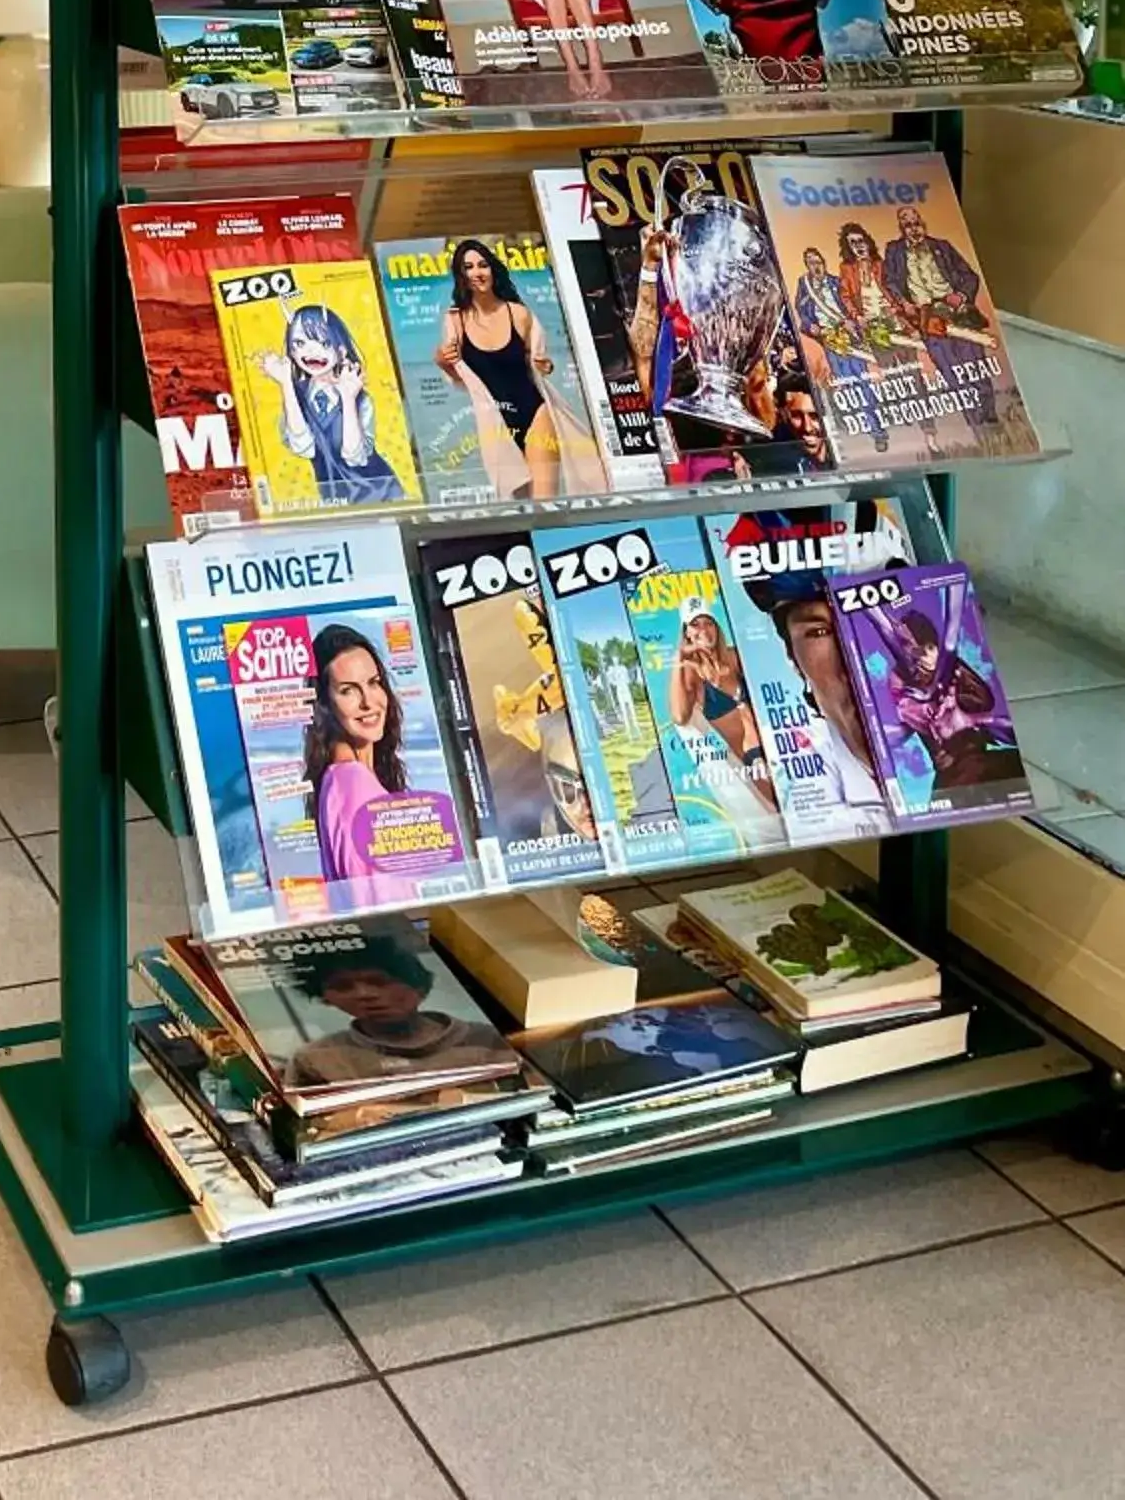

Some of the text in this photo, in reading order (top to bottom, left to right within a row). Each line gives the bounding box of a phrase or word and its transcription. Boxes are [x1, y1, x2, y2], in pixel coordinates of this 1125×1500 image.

[474, 18, 671, 45] Adèle Exarchopoulos
[885, 5, 1025, 35] ANDONNÉES
[899, 35, 971, 56] PINES
[779, 177, 930, 208] Socialter
[386, 238, 548, 280] mari lair
[221, 272, 295, 305] ZOO
[832, 385, 869, 412] QUI
[870, 374, 919, 403] VEUT
[920, 369, 950, 392] LA
[951, 357, 1003, 386] PEAU
[842, 411, 872, 436] DE
[206, 541, 355, 598] PLONGEZ!
[436, 544, 538, 607] ZOO
[549, 533, 653, 599] ZOO
[837, 579, 901, 613] ZOO
[252, 627, 286, 648] TOP
[236, 635, 311, 682] Santé
[761, 683, 790, 707] AU-
[775, 730, 798, 756] DU
[780, 753, 827, 781] TOUR
[506, 833, 583, 856] GODSPEED
[623, 821, 658, 840] MISS
